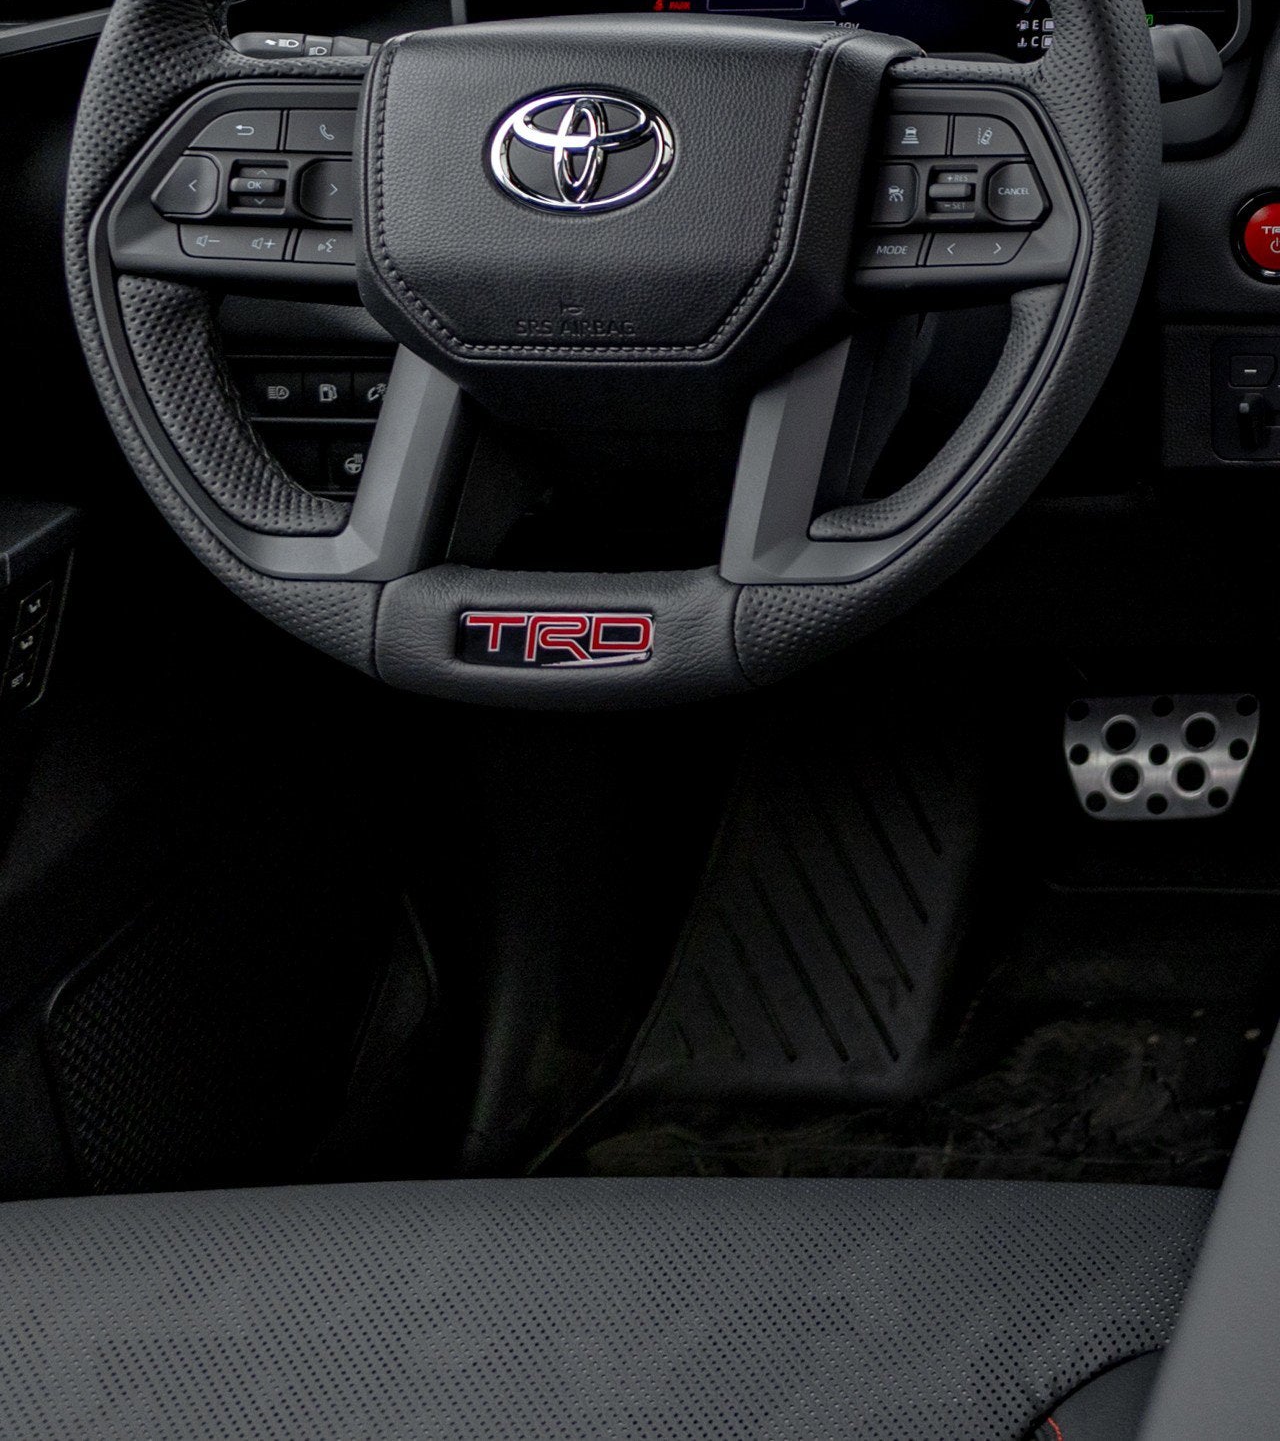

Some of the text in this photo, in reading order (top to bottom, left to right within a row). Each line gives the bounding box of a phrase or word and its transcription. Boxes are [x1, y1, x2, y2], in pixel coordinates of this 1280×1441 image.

[1032, 19, 1040, 31] E
[1031, 35, 1040, 48] C
[247, 180, 262, 190] OK
[997, 187, 1030, 196] CANCEL
[876, 245, 909, 255] MODE
[466, 614, 653, 661] TRD
